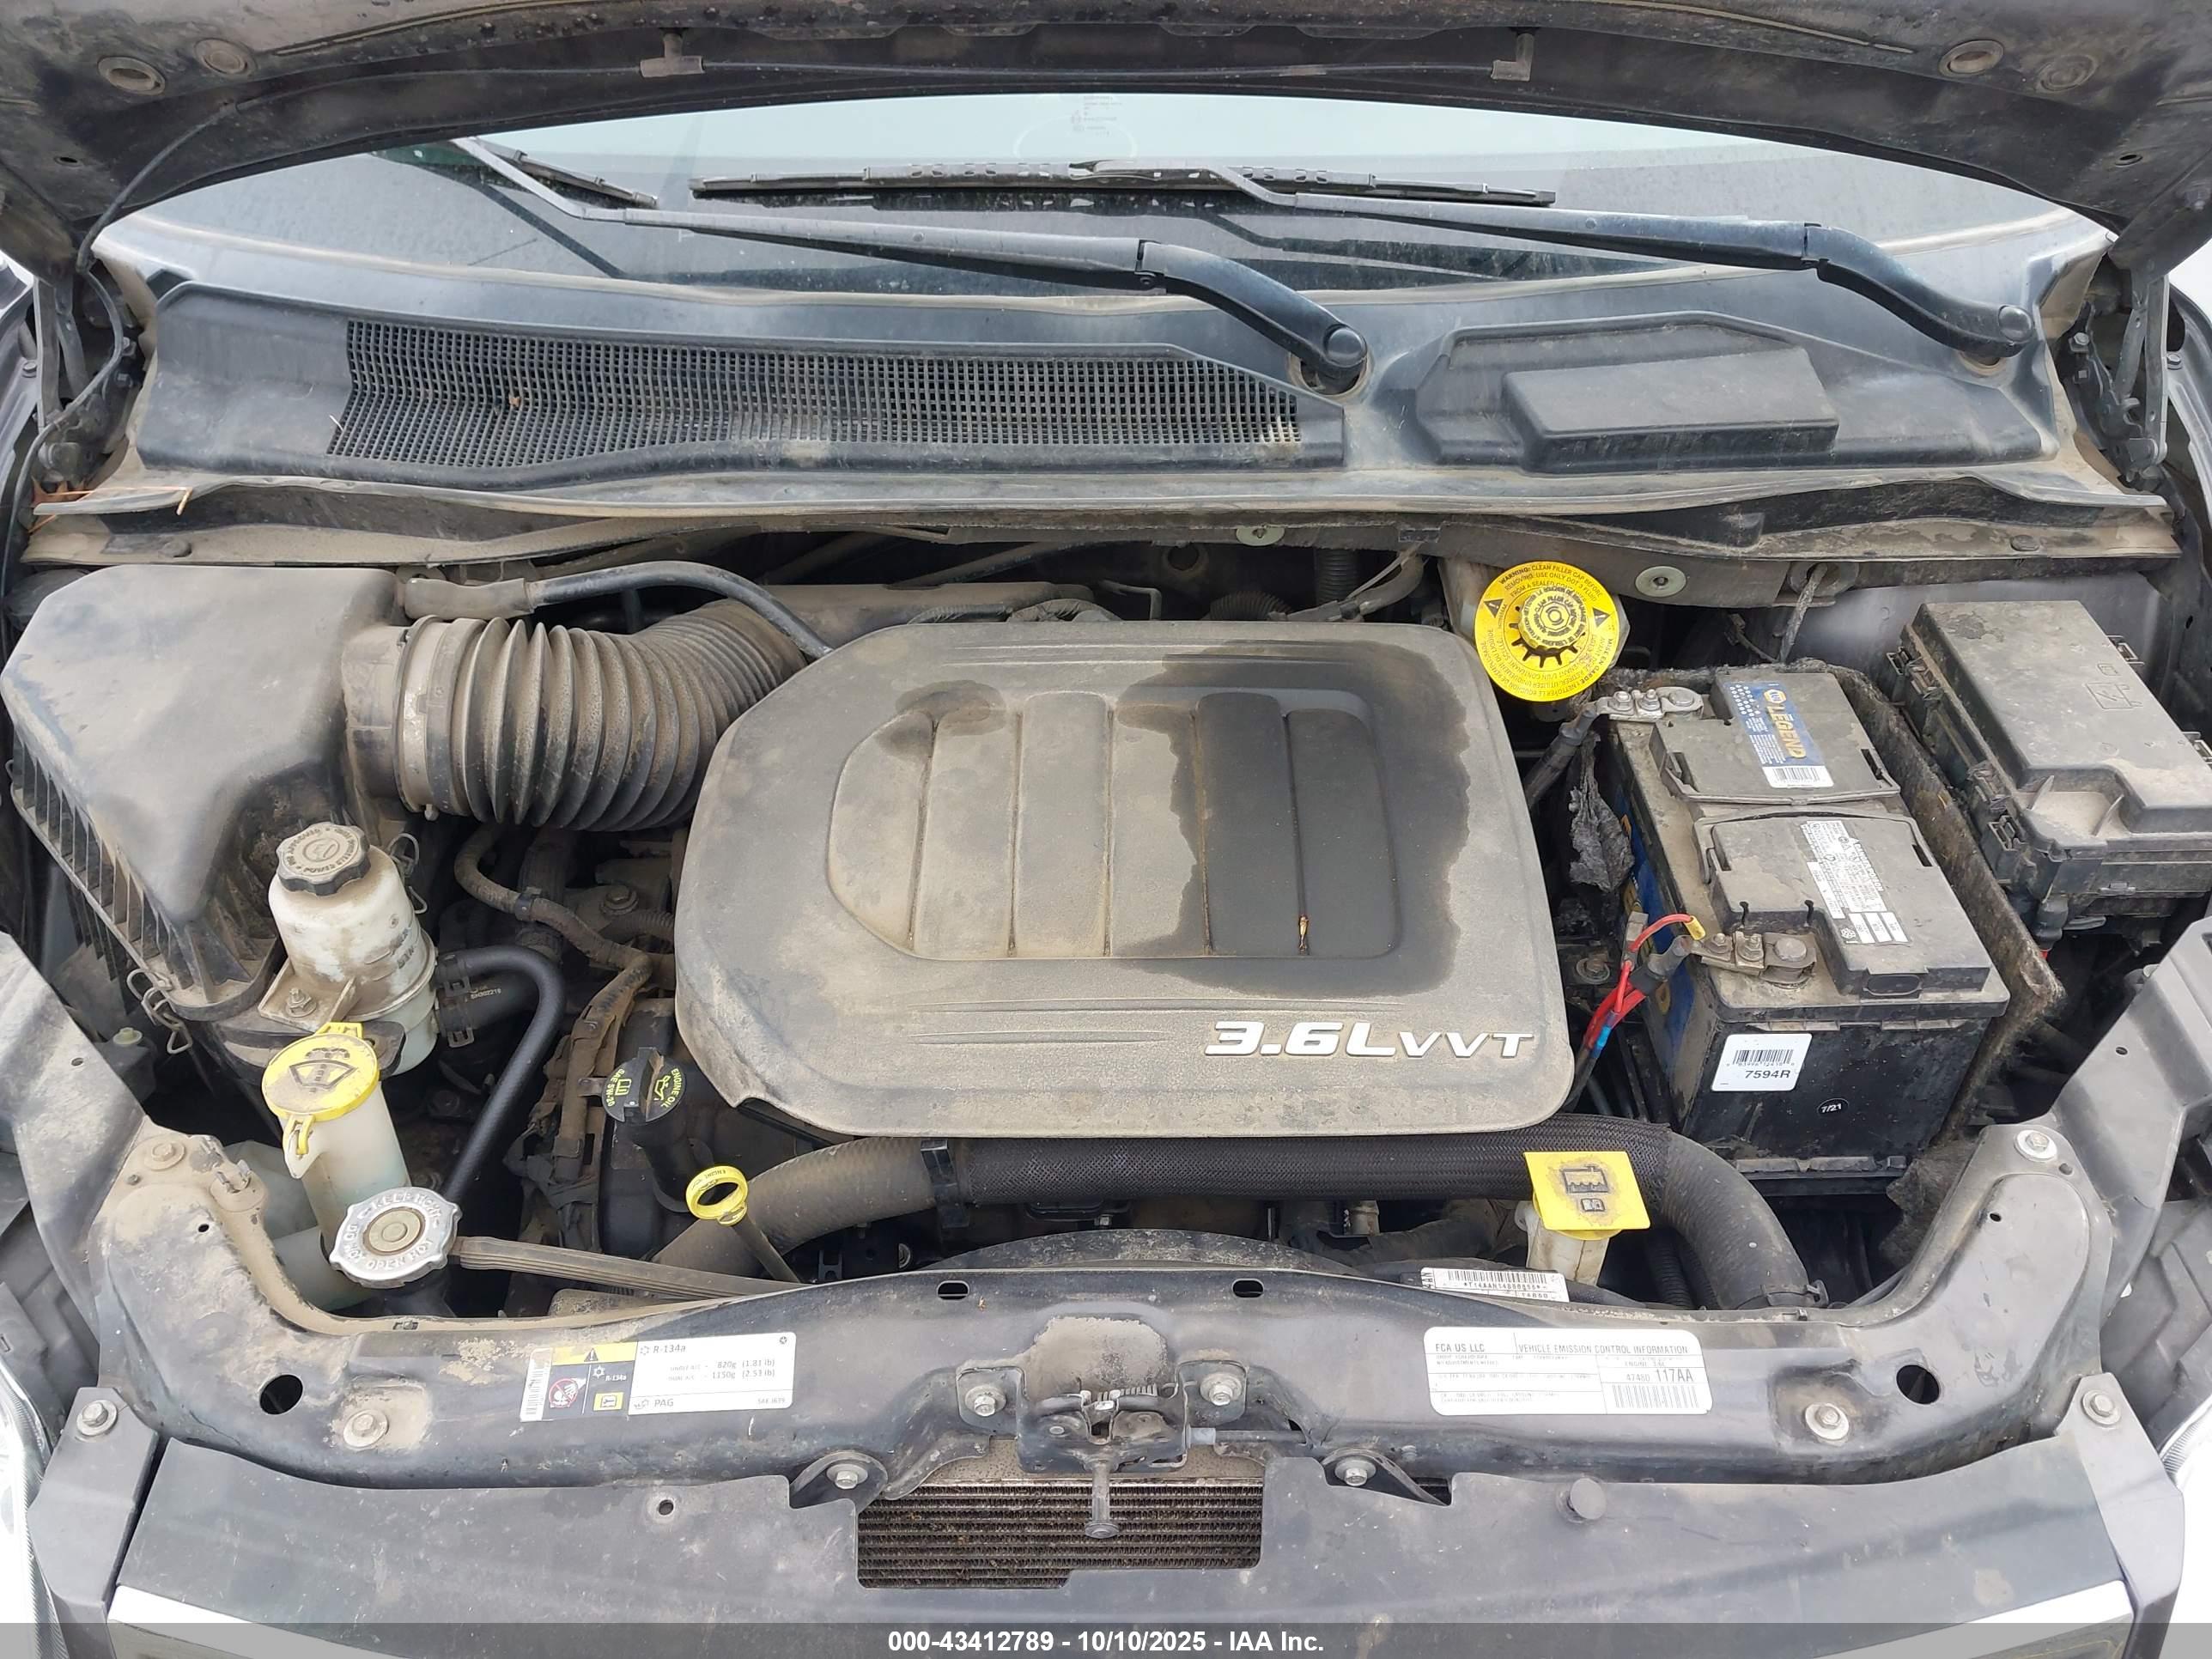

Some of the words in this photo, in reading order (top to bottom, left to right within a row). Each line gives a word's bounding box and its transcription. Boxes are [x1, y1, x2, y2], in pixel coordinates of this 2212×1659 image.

[1498, 566, 1530, 585] WARNING:
[1552, 565, 1571, 574] FILLER
[1571, 571, 1584, 581] CAP
[1583, 578, 1602, 597] BEFORE
[1510, 584, 1526, 597] FROM
[1566, 576, 1578, 585] DOT
[1583, 586, 1596, 601] FLUID
[1603, 638, 1613, 654] MISE
[1597, 655, 1607, 665] EN
[1579, 665, 1600, 684] GARDE
[1766, 706, 1806, 758] LEGEND
[611, 1068, 625, 1085] SAE
[1744, 1070, 1791, 1079] 7594R
[671, 1068, 683, 1097] ENGINE
[605, 1085, 616, 1107] 5W-20
[662, 1096, 676, 1109] OIL
[1820, 1103, 1842, 1114] 7/21
[653, 1344, 686, 1353] R-134a
[1436, 1344, 1451, 1352] FCA
[1455, 1344, 1467, 1352] US
[1469, 1344, 1485, 1352] LLC
[1518, 1344, 1552, 1353] VEHICLE
[1554, 1345, 1592, 1354] EMISSION
[1595, 1345, 1631, 1354] CONTROL
[1633, 1346, 1688, 1354] INFORMATION
[717, 1361, 737, 1370] 820g
[713, 1371, 736, 1380] 1150g
[1655, 1369, 1693, 1382] 117AA
[653, 1399, 674, 1407] PAG
